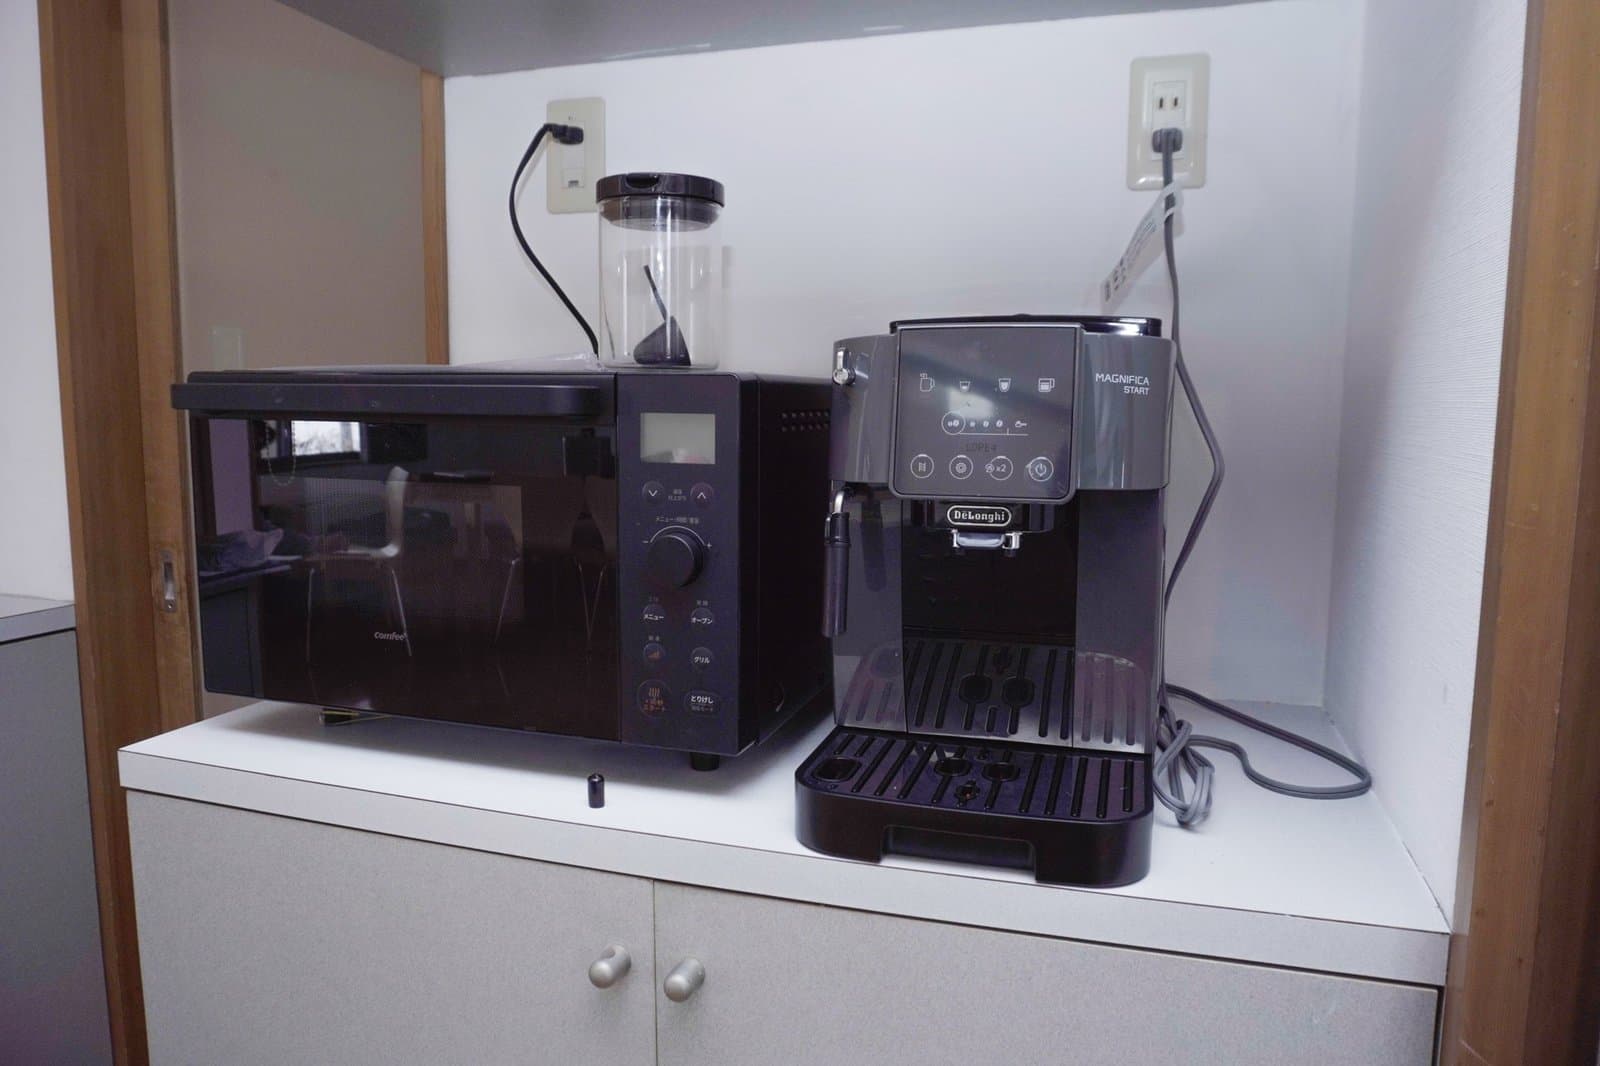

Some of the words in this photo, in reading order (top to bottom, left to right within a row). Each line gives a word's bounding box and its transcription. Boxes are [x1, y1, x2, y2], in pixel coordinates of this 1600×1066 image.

[1095, 373, 1150, 386] MAGNIFICA
[1123, 385, 1150, 395] START
[954, 510, 1005, 523] DeLonghi
[691, 695, 714, 704] とりけし
